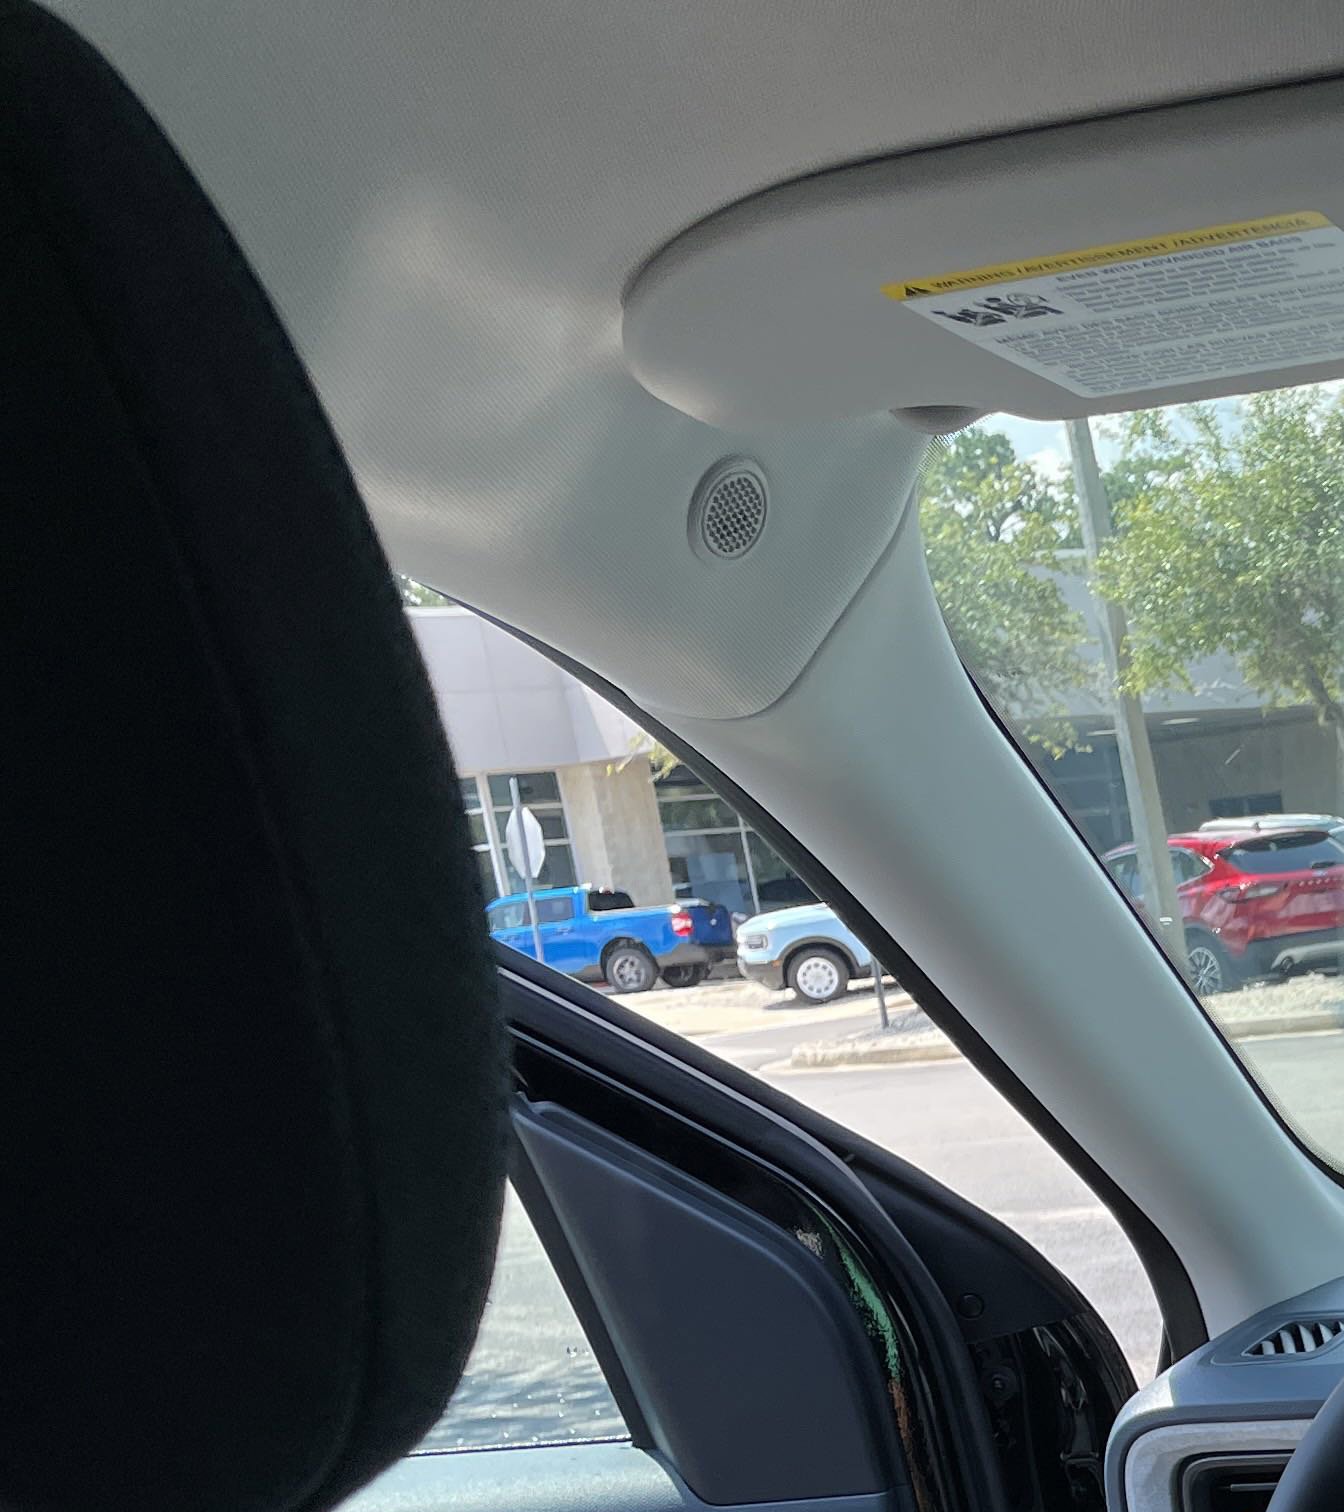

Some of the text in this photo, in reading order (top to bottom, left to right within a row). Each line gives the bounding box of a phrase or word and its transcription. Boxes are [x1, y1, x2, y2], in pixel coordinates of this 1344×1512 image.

[1102, 263, 1140, 274] WITH
[1142, 249, 1225, 267] ADVANCED
[1228, 242, 1255, 254] AIR
[1256, 236, 1303, 249] BAGS
